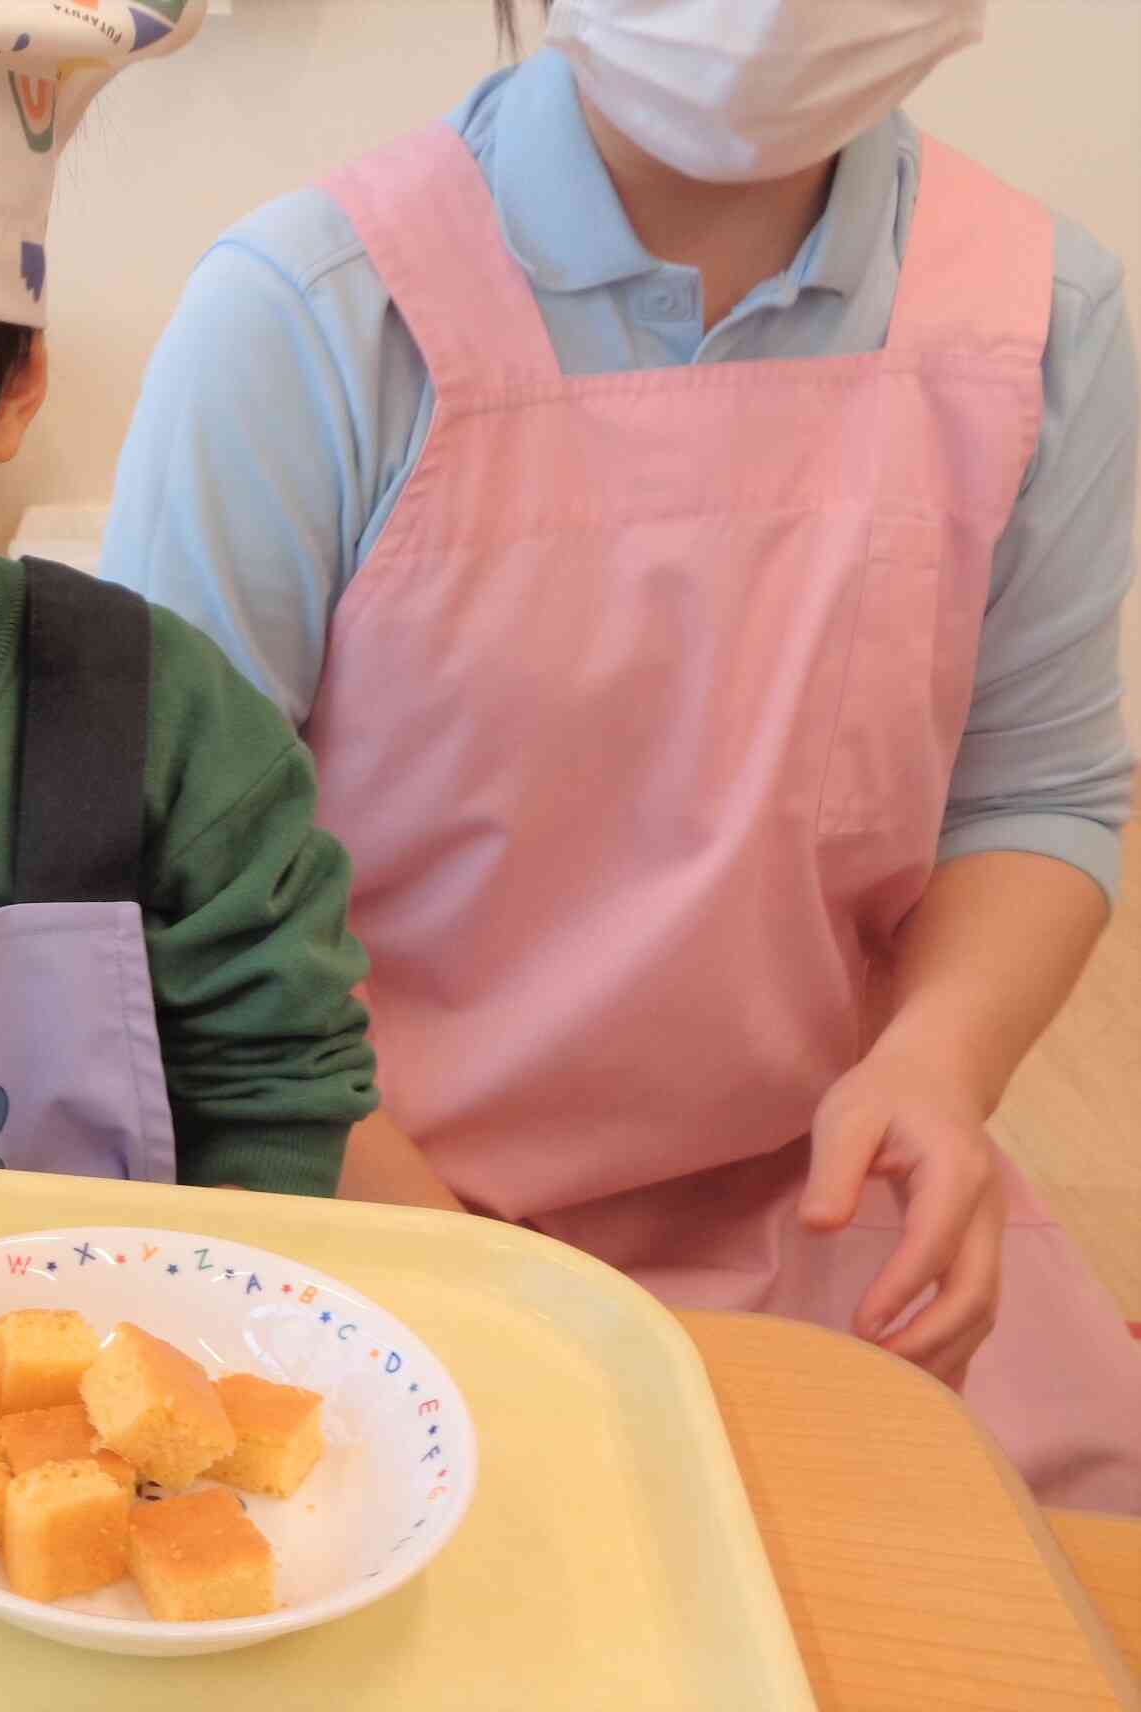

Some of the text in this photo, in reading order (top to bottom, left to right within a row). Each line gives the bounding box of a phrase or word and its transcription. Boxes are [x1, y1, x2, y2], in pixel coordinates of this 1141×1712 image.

[73, 1242, 98, 1267] X
[140, 1241, 161, 1263] Y
[194, 1248, 215, 1271] Z
[7, 1253, 33, 1276] W
[245, 1272, 263, 1295] A
[298, 1284, 319, 1305] B
[337, 1322, 357, 1341] C
[384, 1351, 403, 1374] D
[417, 1399, 441, 1417] E
[420, 1444, 442, 1464] F
